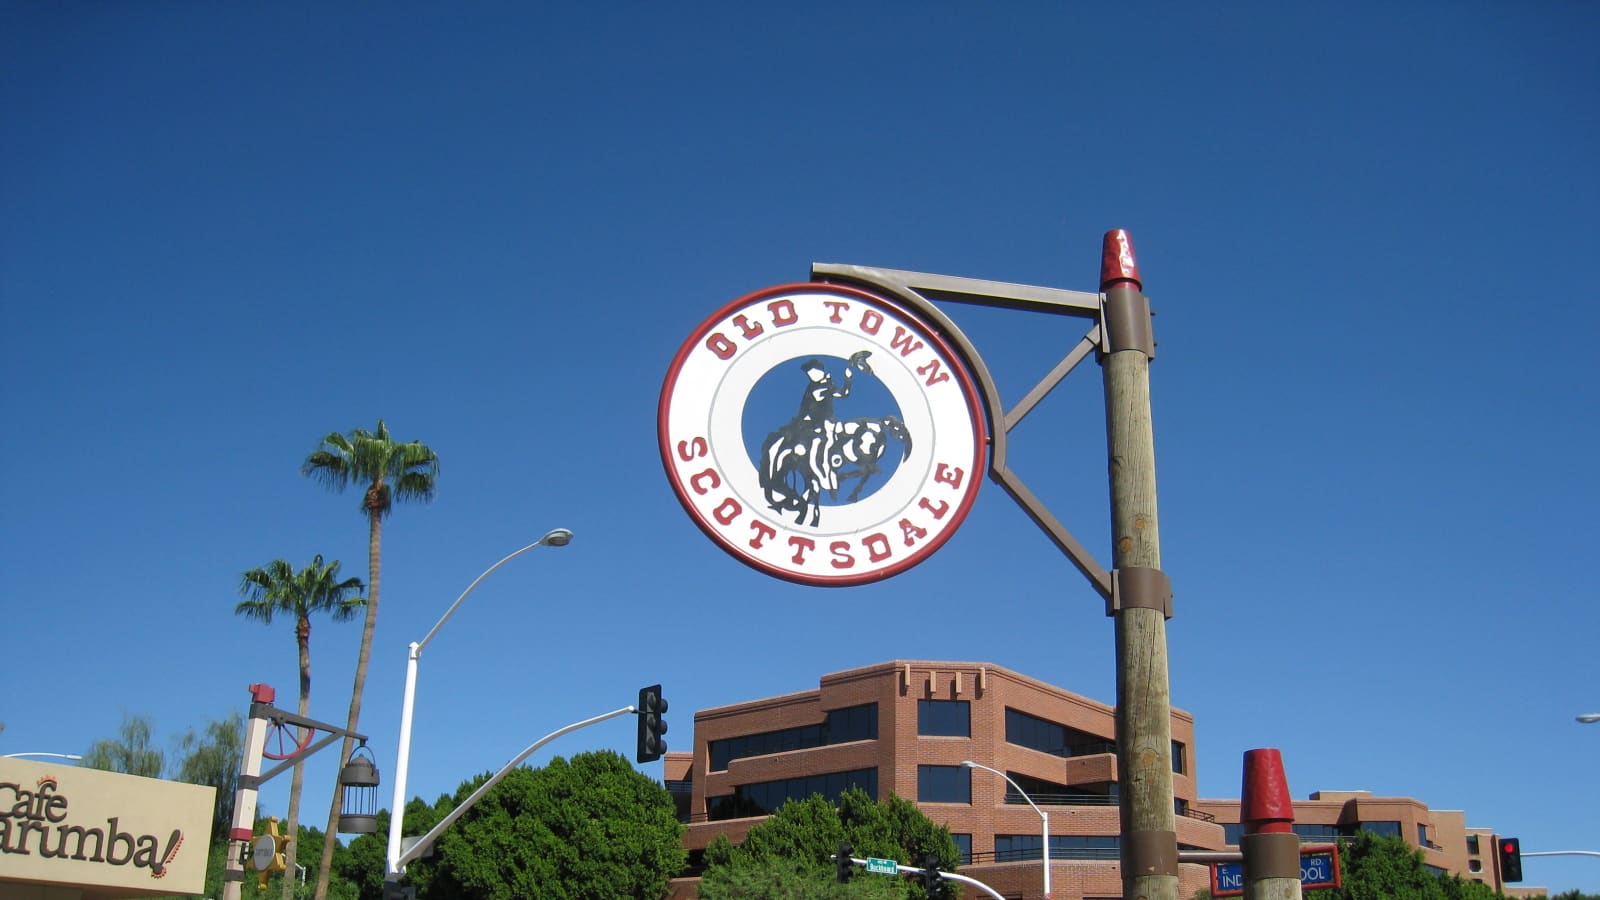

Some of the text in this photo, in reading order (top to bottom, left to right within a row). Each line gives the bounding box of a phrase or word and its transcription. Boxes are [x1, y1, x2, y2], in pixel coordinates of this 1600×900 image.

[706, 299, 949, 387] OLD TOWN
[677, 436, 964, 569] SCOTTSDALE
[0, 782, 68, 823] Cafe
